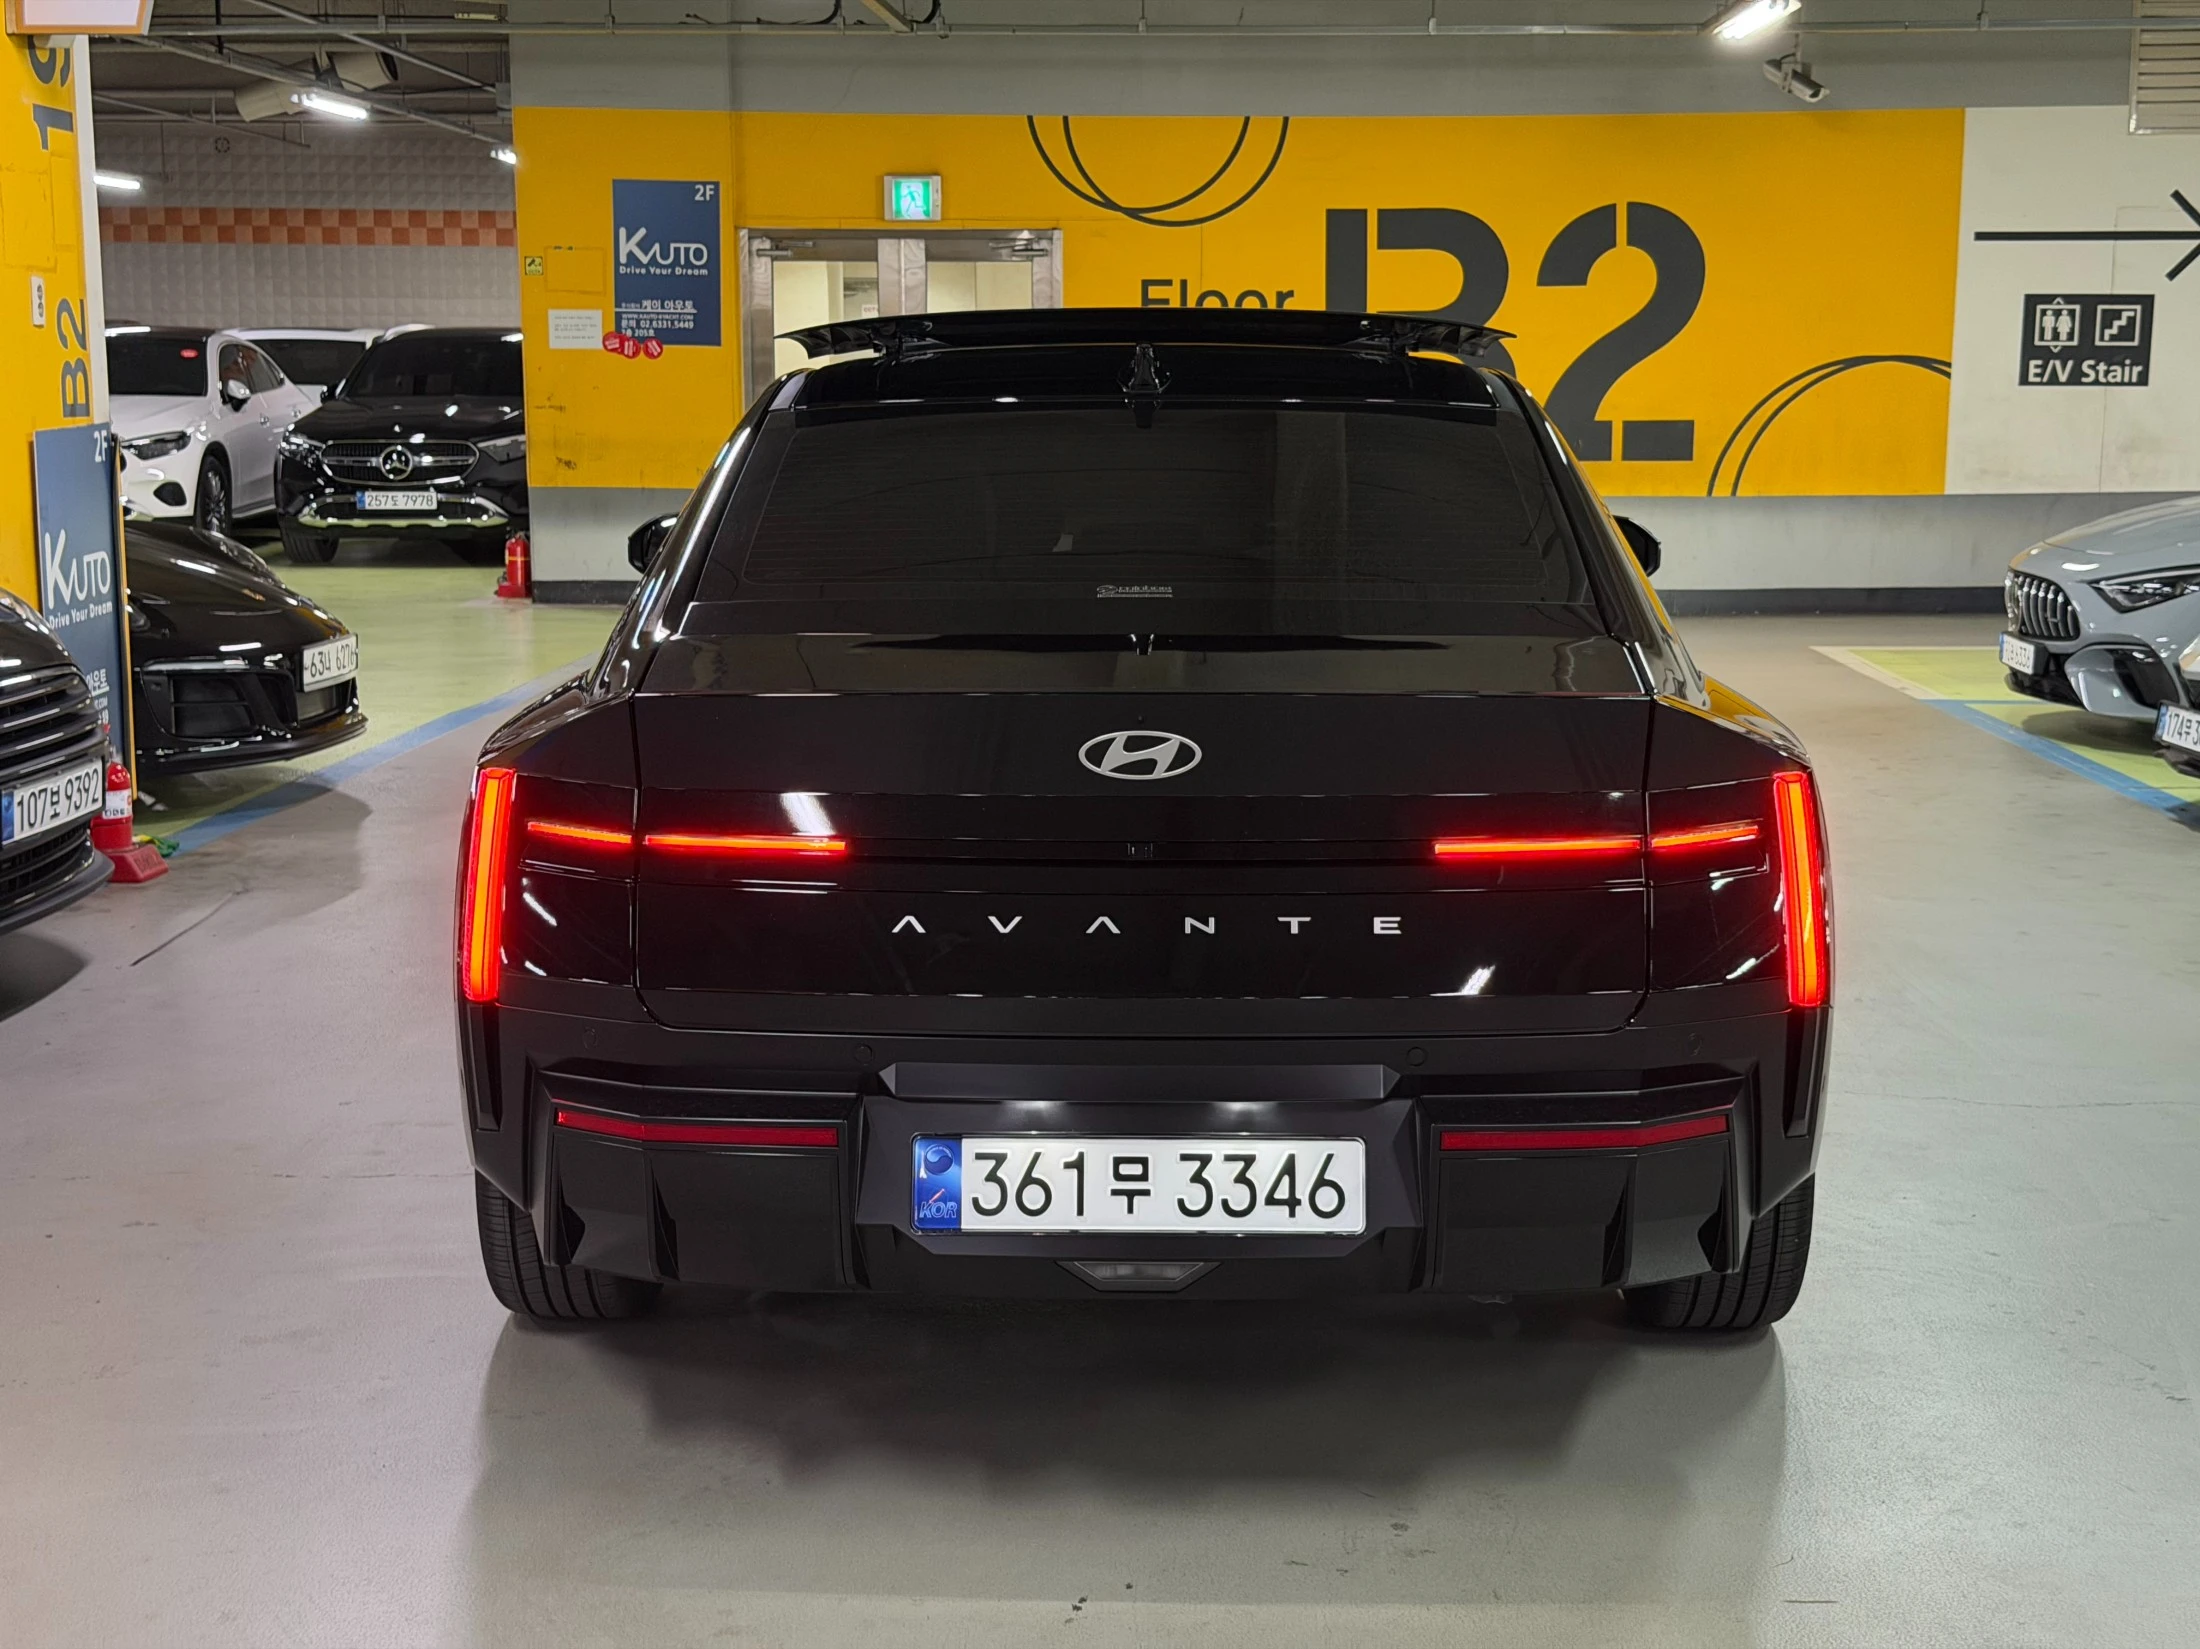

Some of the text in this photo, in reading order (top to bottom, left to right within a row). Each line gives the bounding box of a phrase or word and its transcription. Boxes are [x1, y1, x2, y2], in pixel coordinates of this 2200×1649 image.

[694, 184, 715, 201] 2F
[619, 265, 708, 276] Drive Your Dream
[1140, 279, 1295, 309] Floor
[1325, 201, 1706, 461] B2
[56, 298, 91, 419] B2
[2027, 359, 2144, 384] E/V Stair
[93, 430, 107, 463] 2F
[402, 494, 434, 507] 7978
[49, 600, 113, 630] Drive Your Dream
[17, 767, 99, 832] 107보 9392
[891, 914, 1402, 936] AVANTE
[1176, 1152, 1346, 1220] 3346
[919, 1201, 958, 1219] KOR
